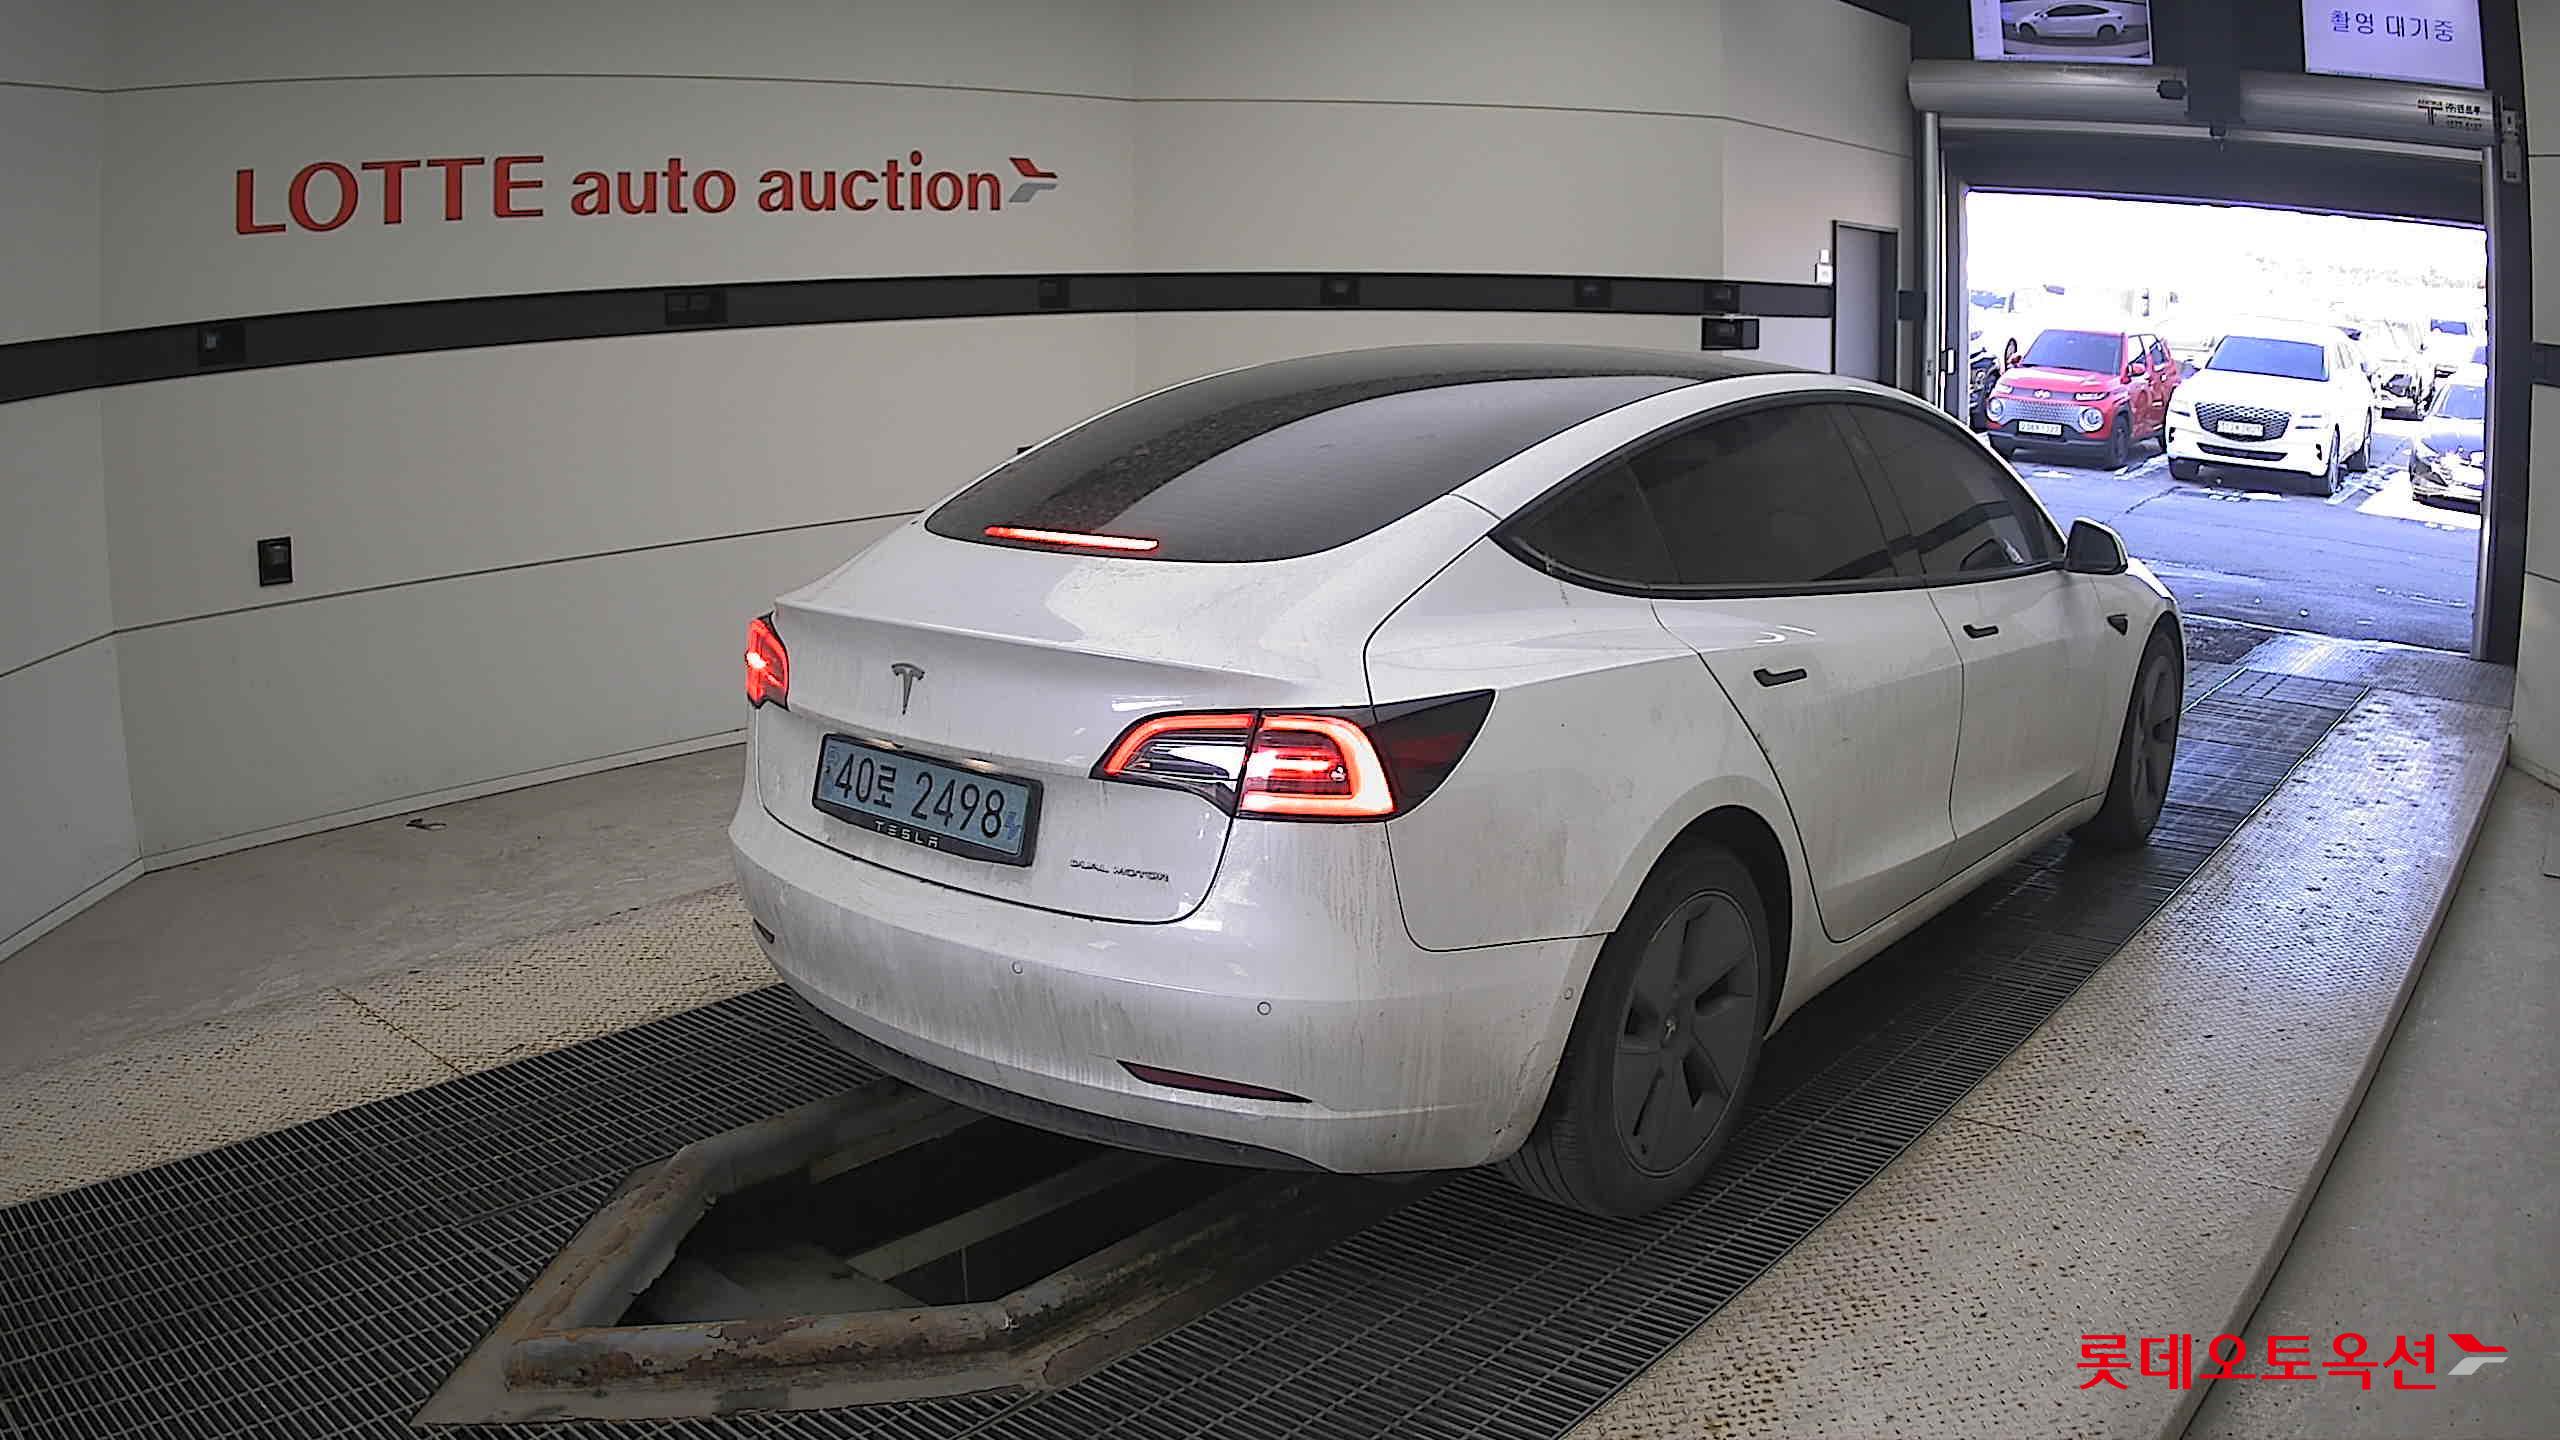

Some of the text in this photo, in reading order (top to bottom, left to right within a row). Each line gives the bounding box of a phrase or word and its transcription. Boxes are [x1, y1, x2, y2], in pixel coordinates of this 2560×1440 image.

[2330, 9, 2454, 42] 촬영 대기중
[235, 150, 1002, 235] LOTTE auto auction
[834, 753, 1005, 838] 40로 2498
[874, 820, 941, 848] TESLA
